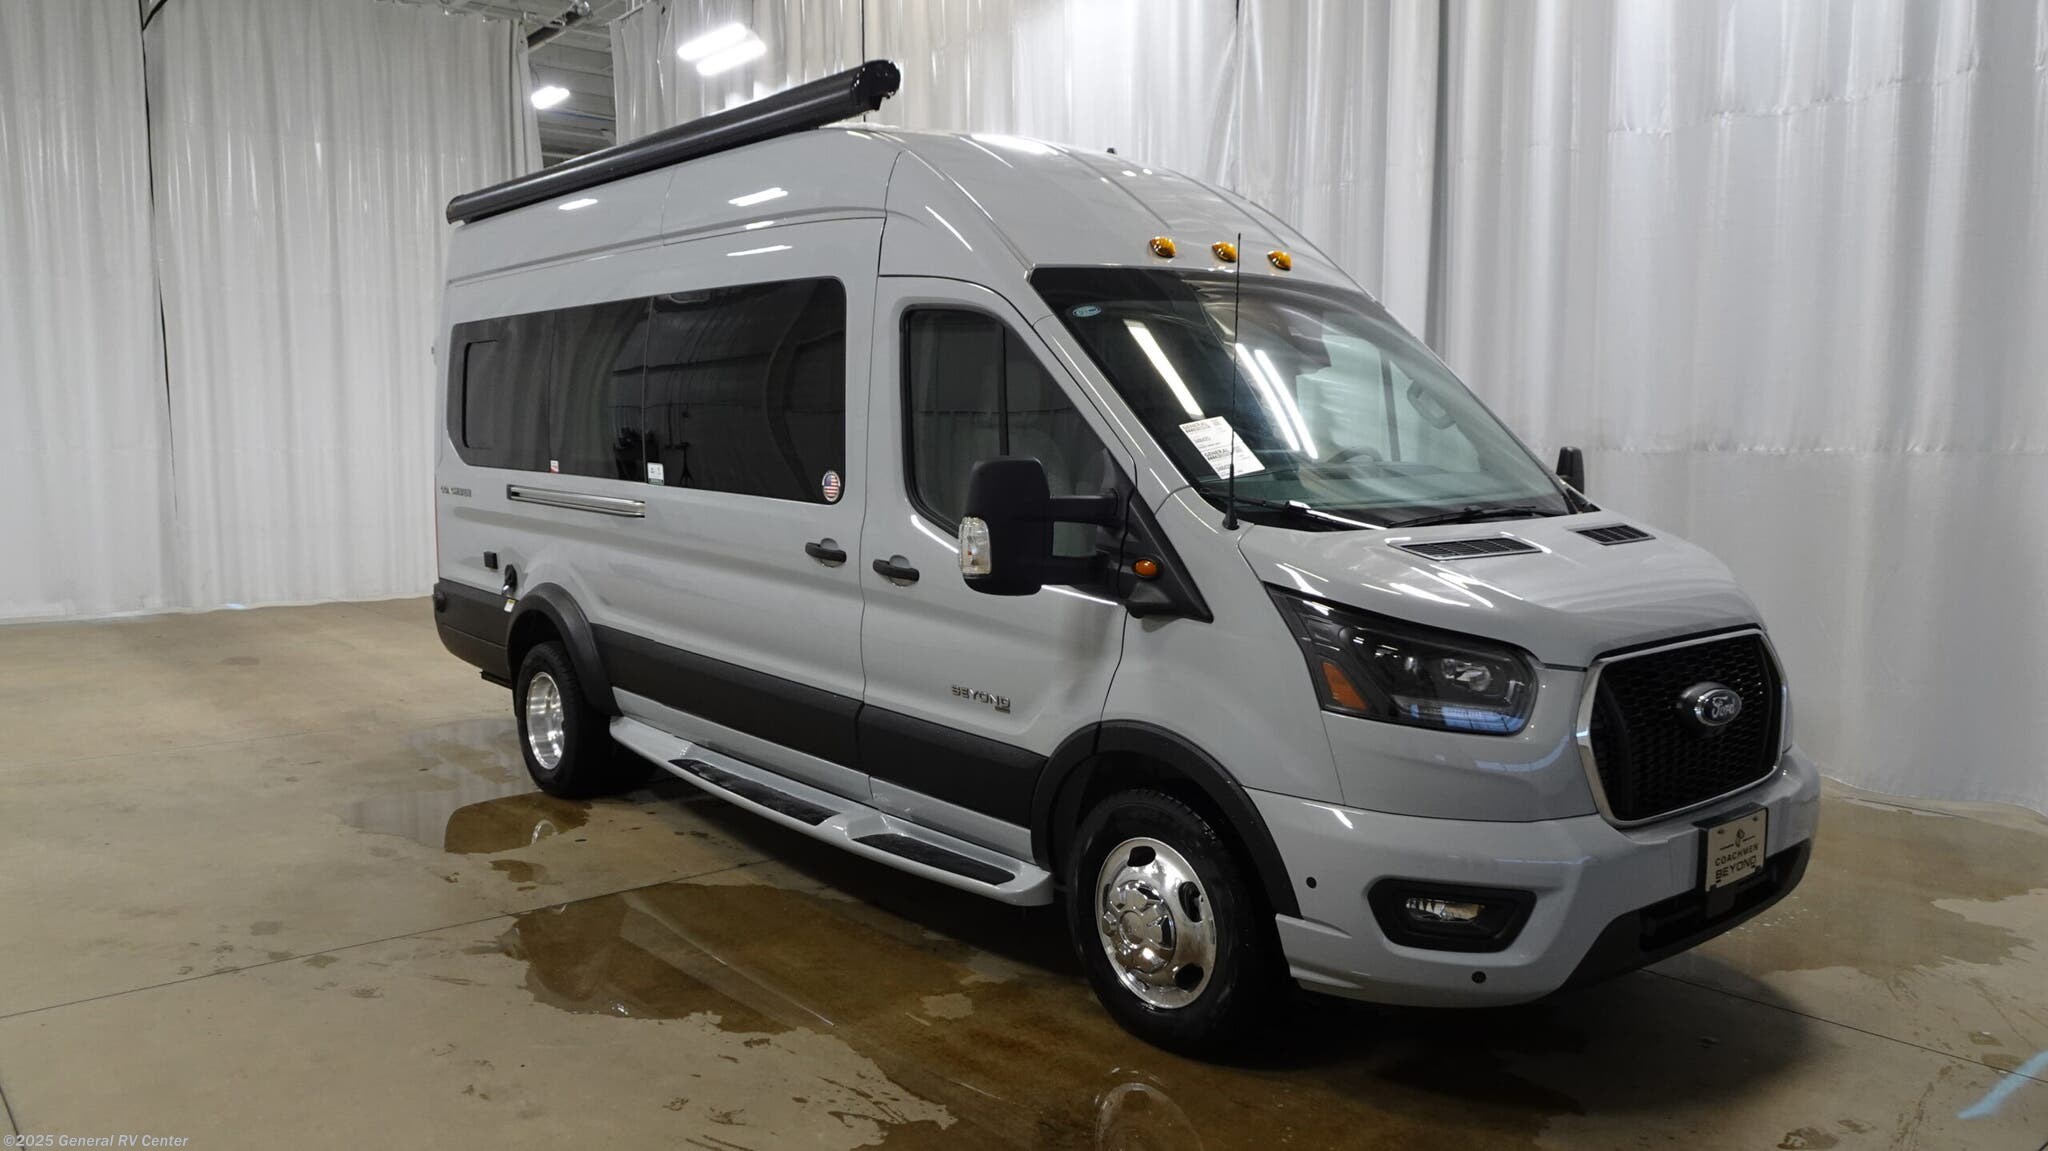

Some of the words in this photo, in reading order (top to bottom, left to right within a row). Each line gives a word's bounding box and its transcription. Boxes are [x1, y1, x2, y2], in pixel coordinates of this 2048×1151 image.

[951, 685, 1011, 709] BEYOND
[1712, 695, 1736, 719] Ford
[1714, 844, 1759, 867] COACHMEN
[1715, 855, 1758, 884] BEYOND
